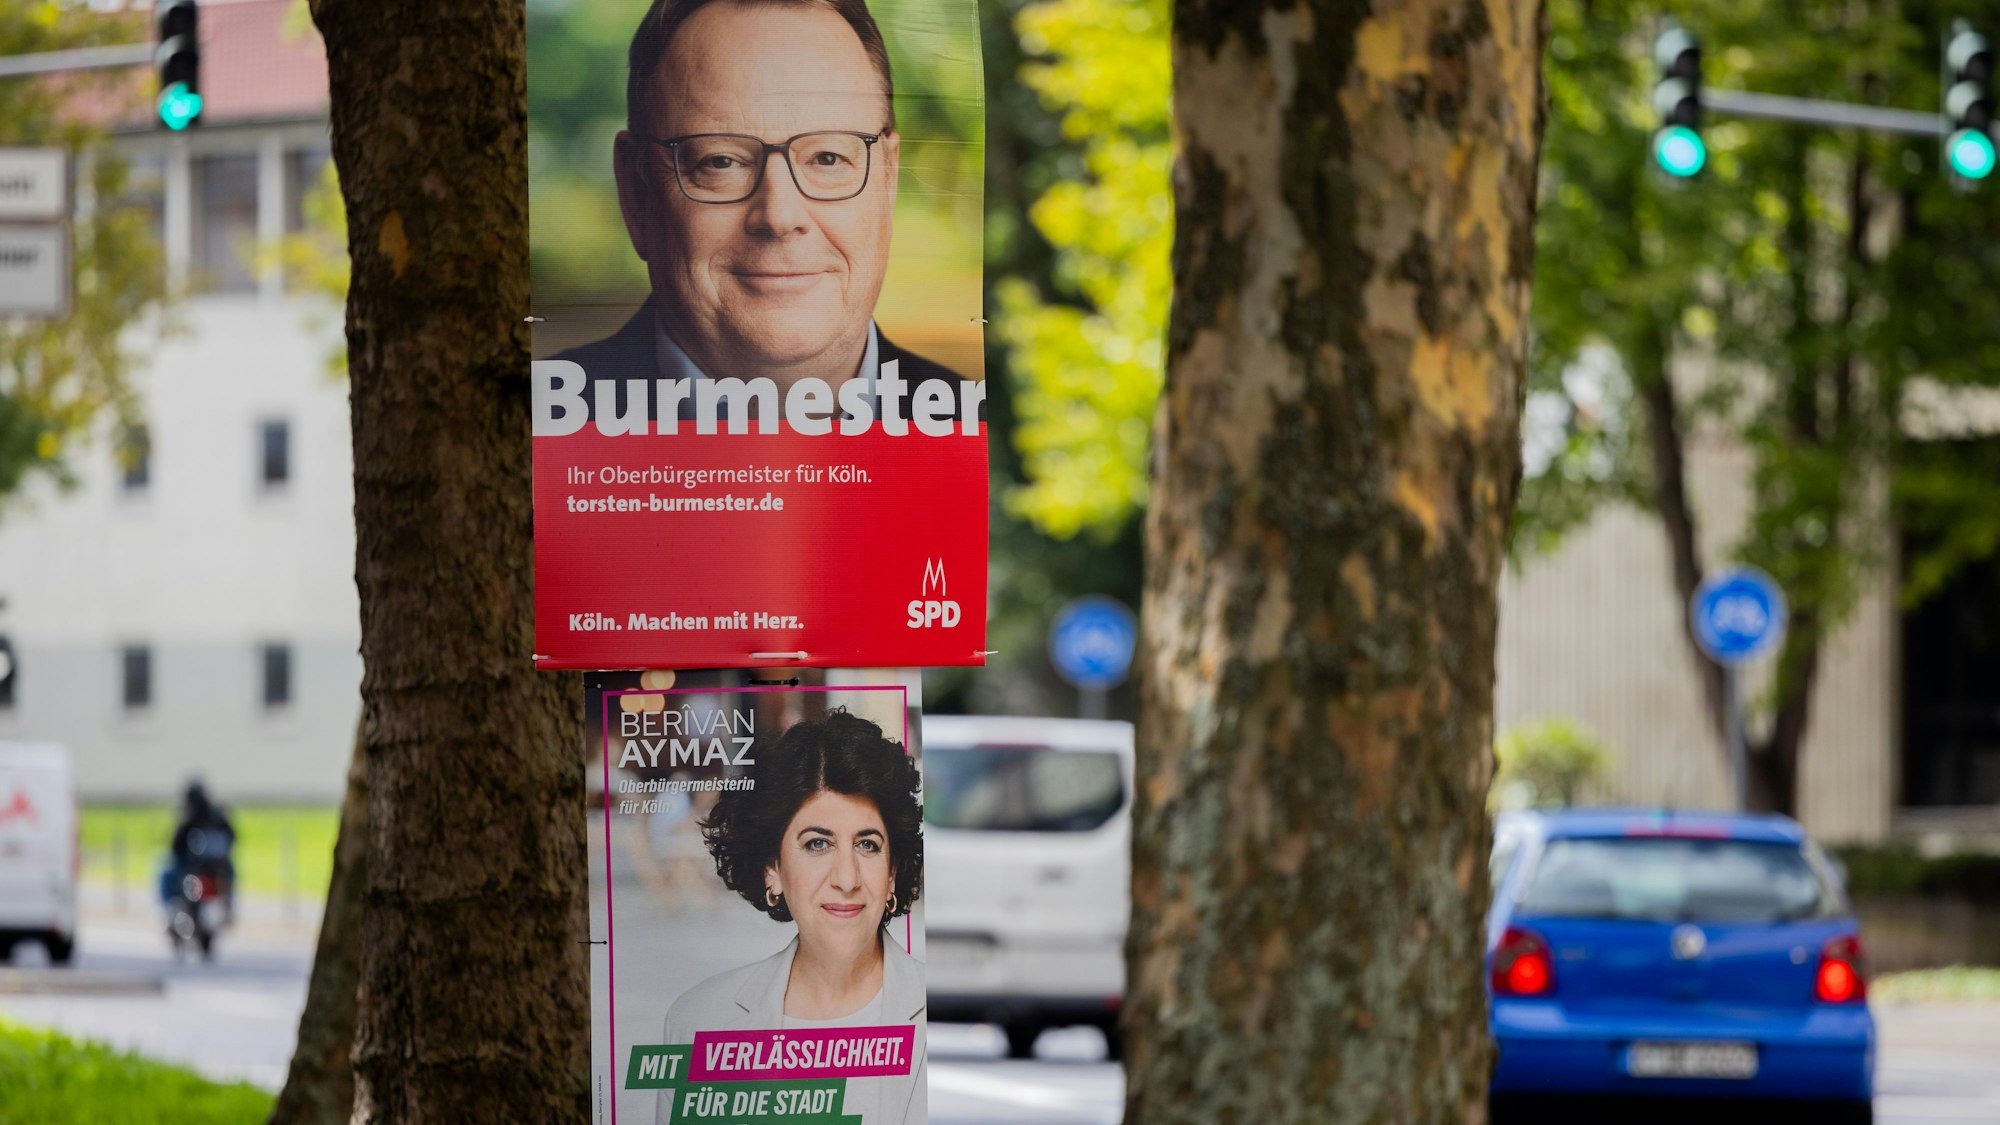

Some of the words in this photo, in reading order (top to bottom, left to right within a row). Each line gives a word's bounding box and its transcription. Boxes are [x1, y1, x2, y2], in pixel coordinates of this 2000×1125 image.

[531, 359, 986, 437] Burmester
[567, 465, 594, 485] Ihr
[599, 464, 791, 488] Oberbürgermeister
[796, 464, 823, 484] für
[828, 465, 872, 484] Köln.
[567, 492, 784, 513] torsten-burmester.de
[569, 613, 622, 631] Köln.
[627, 613, 708, 631] Machen
[713, 611, 748, 630] mit
[754, 611, 804, 630] Herz.
[907, 600, 961, 629] SPD
[621, 704, 754, 736] BERÎVAN
[618, 738, 755, 768] AYMAZ
[619, 777, 755, 794] Oberbürgermeisterin
[619, 800, 638, 815] für
[641, 800, 671, 814] Köln
[638, 1054, 683, 1080] MIT
[705, 1034, 905, 1071] VERLÄSSLICHKEIT.
[682, 1086, 728, 1117] FÜR
[731, 1089, 771, 1116] DIE
[773, 1088, 838, 1115] STADT
